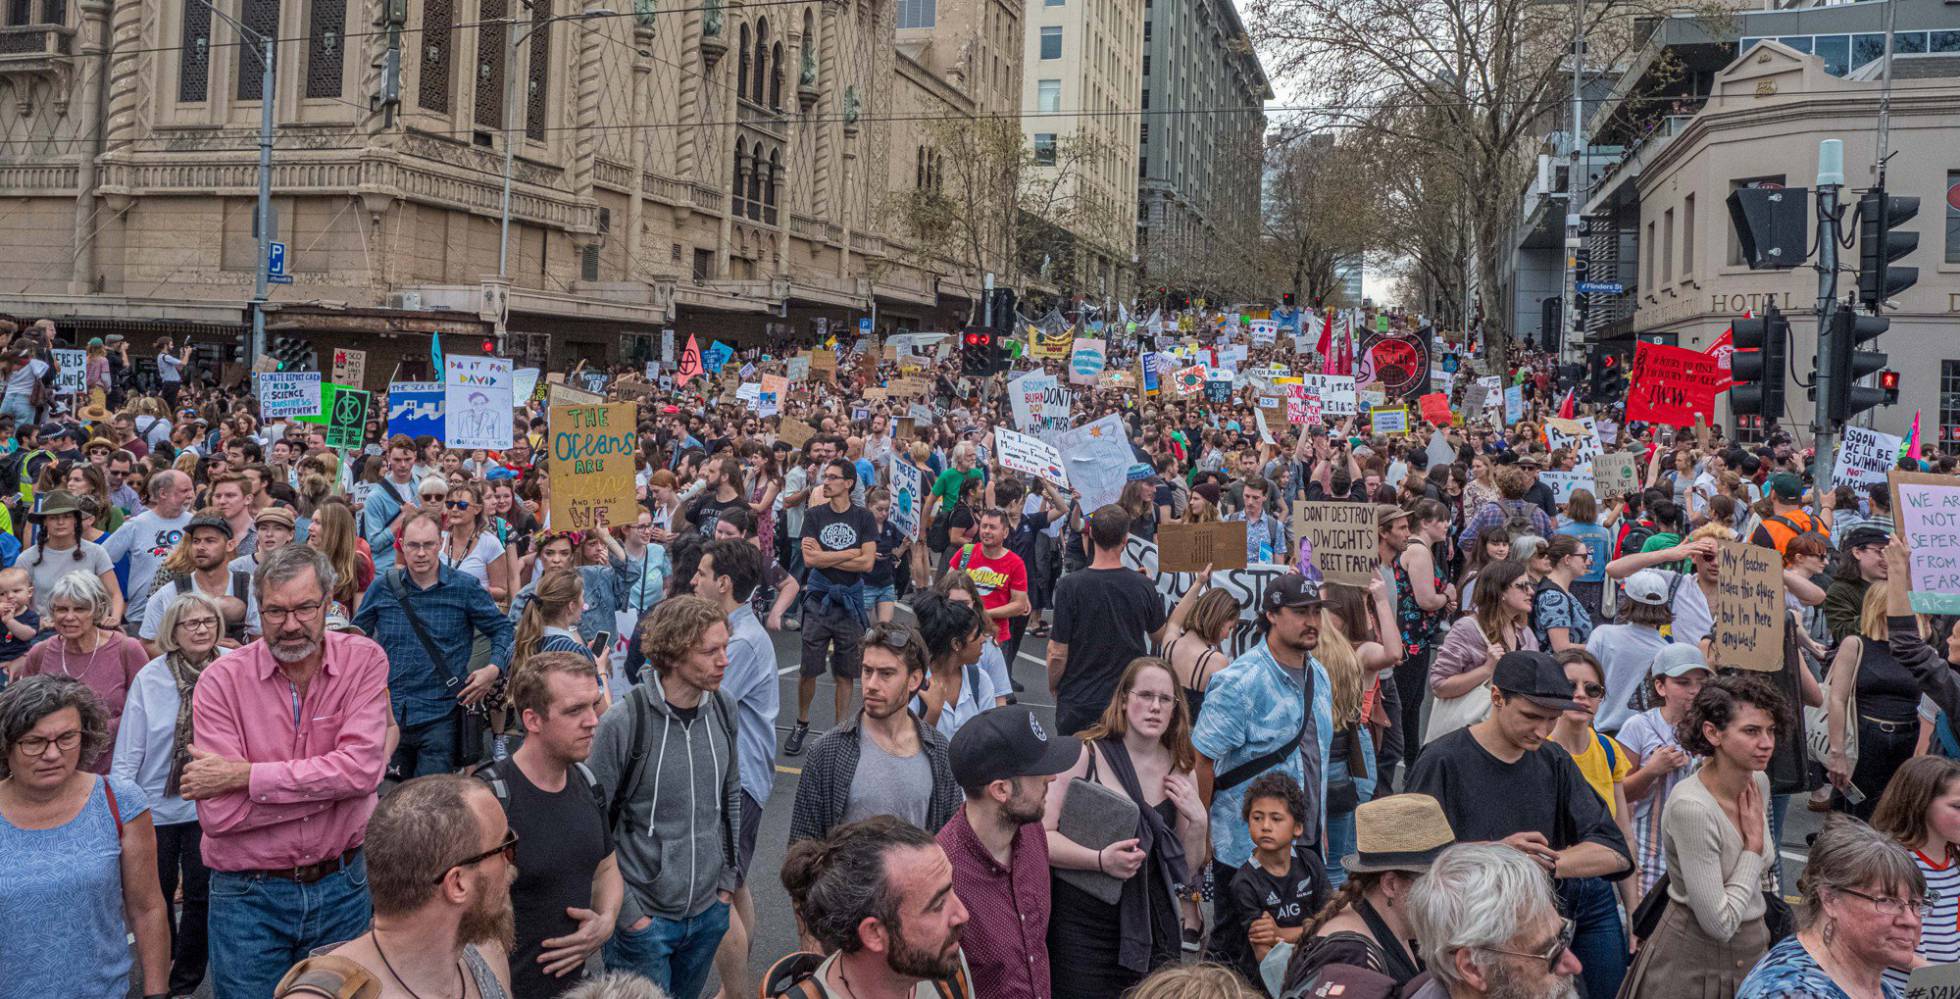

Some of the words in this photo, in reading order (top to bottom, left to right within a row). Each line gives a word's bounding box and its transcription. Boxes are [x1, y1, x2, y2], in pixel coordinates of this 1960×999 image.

[272, 245, 282, 258] P
[1712, 292, 1798, 312] HOTL
[74, 354, 82, 366] IS
[77, 370, 85, 391] B
[273, 382, 296, 390] KIDS
[272, 390, 304, 400] SCIENCE
[568, 407, 609, 428] THE
[1847, 430, 1876, 448] SOON
[1877, 449, 1893, 462] BE
[575, 460, 604, 474] ARE
[1846, 468, 1865, 478] NOT
[907, 481, 917, 498] NO
[1552, 481, 1561, 496] B
[1907, 493, 1933, 508] WE
[569, 506, 610, 527] WE
[1304, 504, 1330, 522] DON'T
[1332, 506, 1375, 524] DESTROY
[1922, 512, 1956, 526] NOT
[1313, 528, 1373, 550] DWIGHT'S
[1320, 553, 1342, 571] BEET
[1345, 555, 1379, 573] FARM
[1722, 549, 1738, 576] My
[1740, 549, 1768, 575] Teacher
[1917, 555, 1956, 569] FROM
[1754, 602, 1771, 628] here
[1277, 903, 1301, 919] AIG
